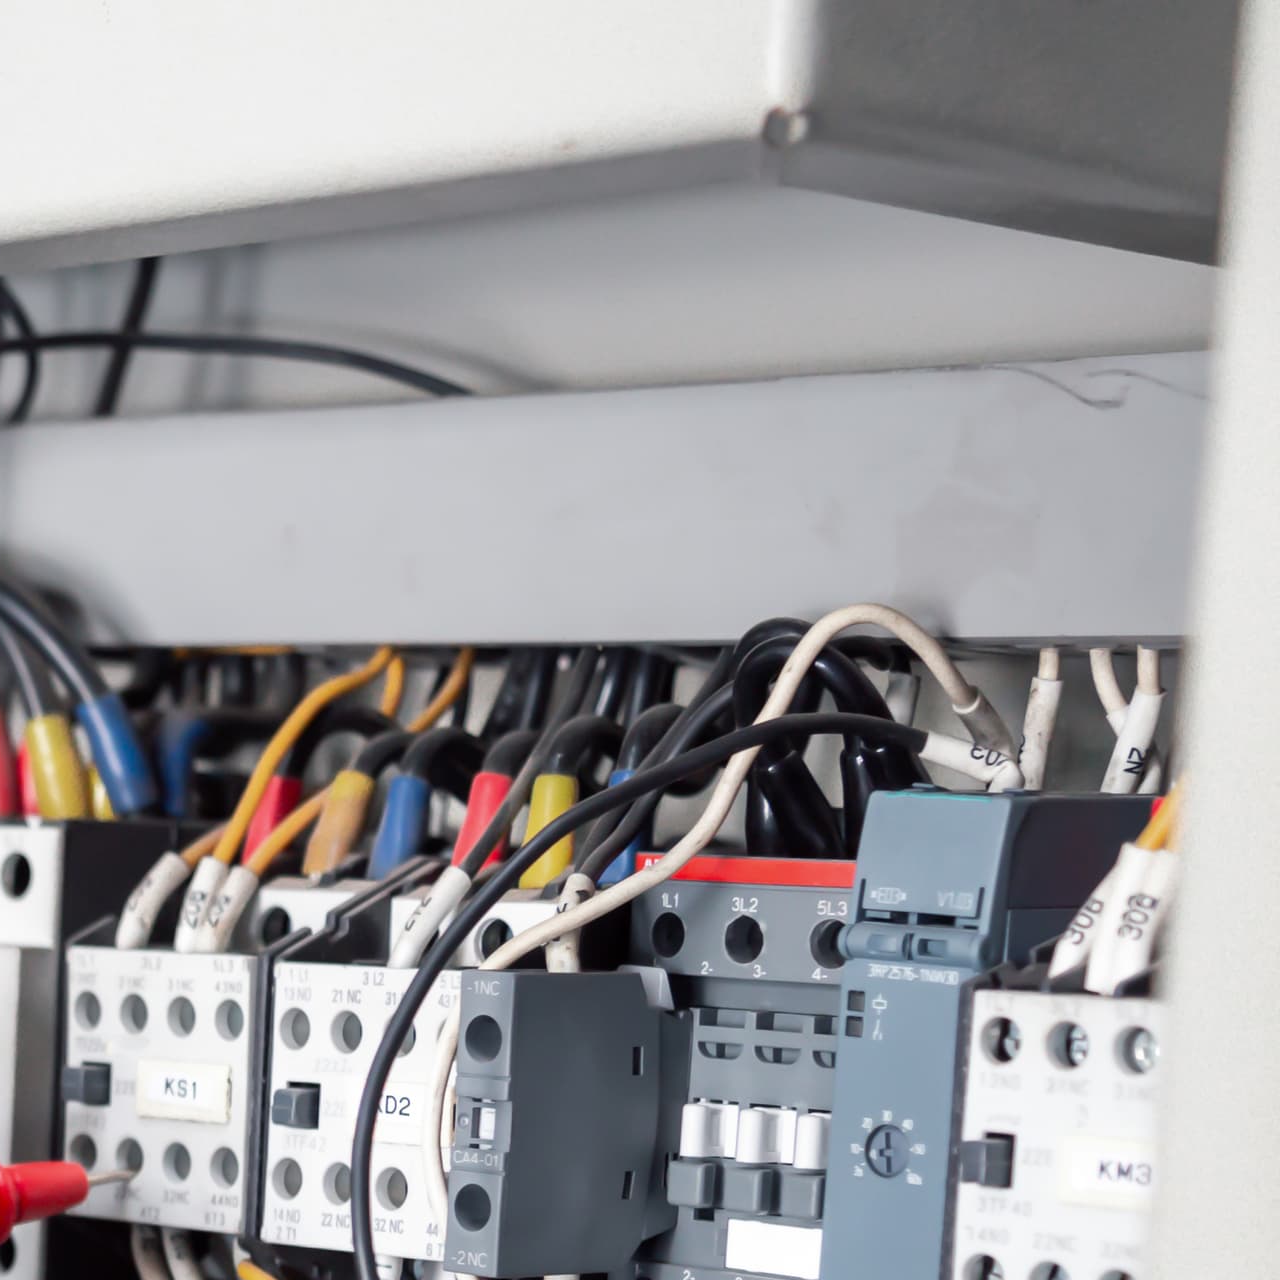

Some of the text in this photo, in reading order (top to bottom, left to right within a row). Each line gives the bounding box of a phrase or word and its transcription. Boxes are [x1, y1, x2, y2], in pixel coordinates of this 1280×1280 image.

[732, 897, 759, 913] 3L2
[817, 901, 848, 917] 5L3
[164, 1077, 197, 1100] KS1
[1097, 1159, 1153, 1187] KM3
